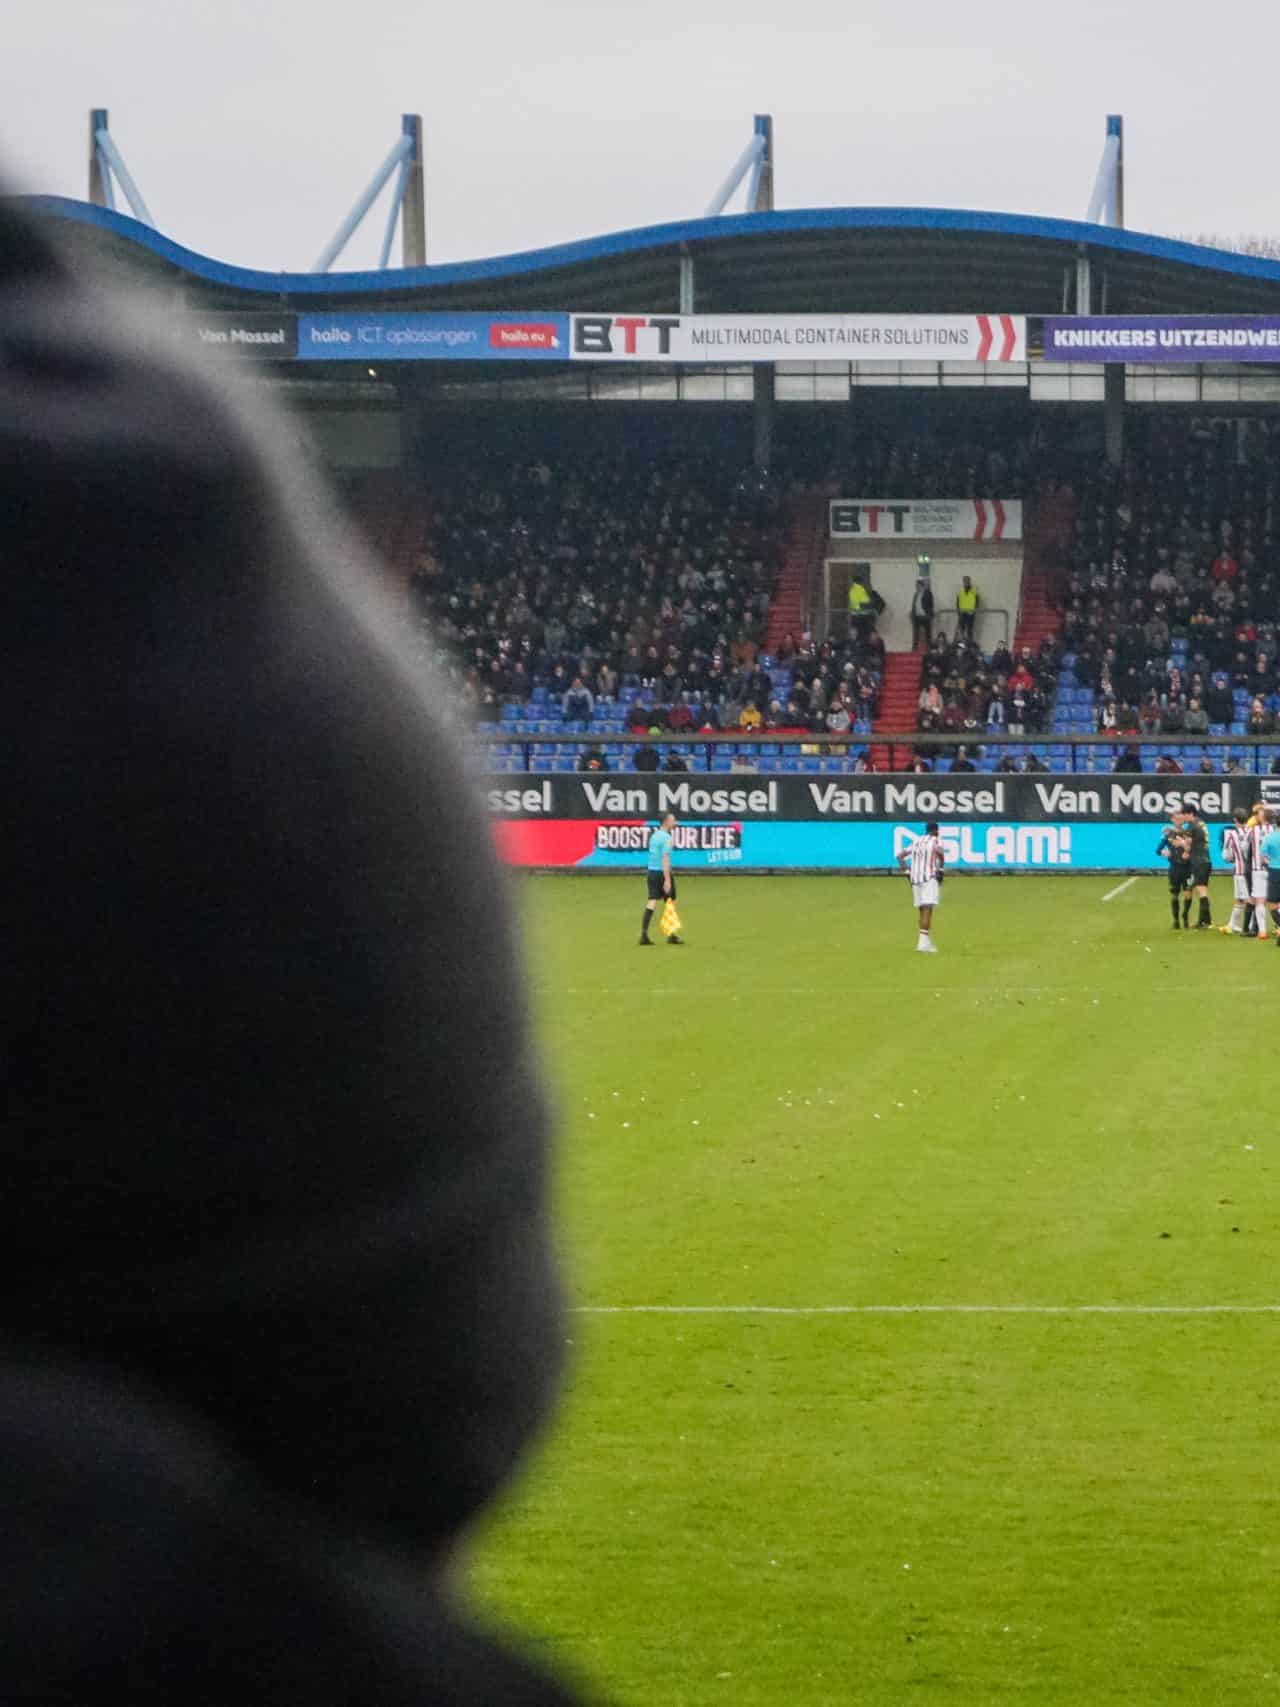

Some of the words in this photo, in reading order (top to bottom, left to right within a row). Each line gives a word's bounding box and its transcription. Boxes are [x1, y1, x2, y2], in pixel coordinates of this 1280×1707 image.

[230, 328, 284, 343] Mossel
[358, 328, 382, 343] ICT
[574, 317, 680, 354] BTT
[692, 328, 791, 345] MULTIMODAL
[796, 328, 883, 345] CONTAINER
[884, 327, 969, 344] SOLUTIONS
[1054, 330, 1156, 347] KNIKKERS
[831, 506, 909, 532] BTT
[582, 783, 647, 812] Van
[658, 781, 777, 812] Mossel
[808, 783, 873, 813] Van
[884, 782, 1004, 813] Mossel
[1035, 784, 1100, 813] Van
[1111, 783, 1231, 814] Mossel
[598, 826, 649, 848] BOOST
[701, 827, 736, 848] LIFE
[938, 826, 1072, 864] SLAM!
